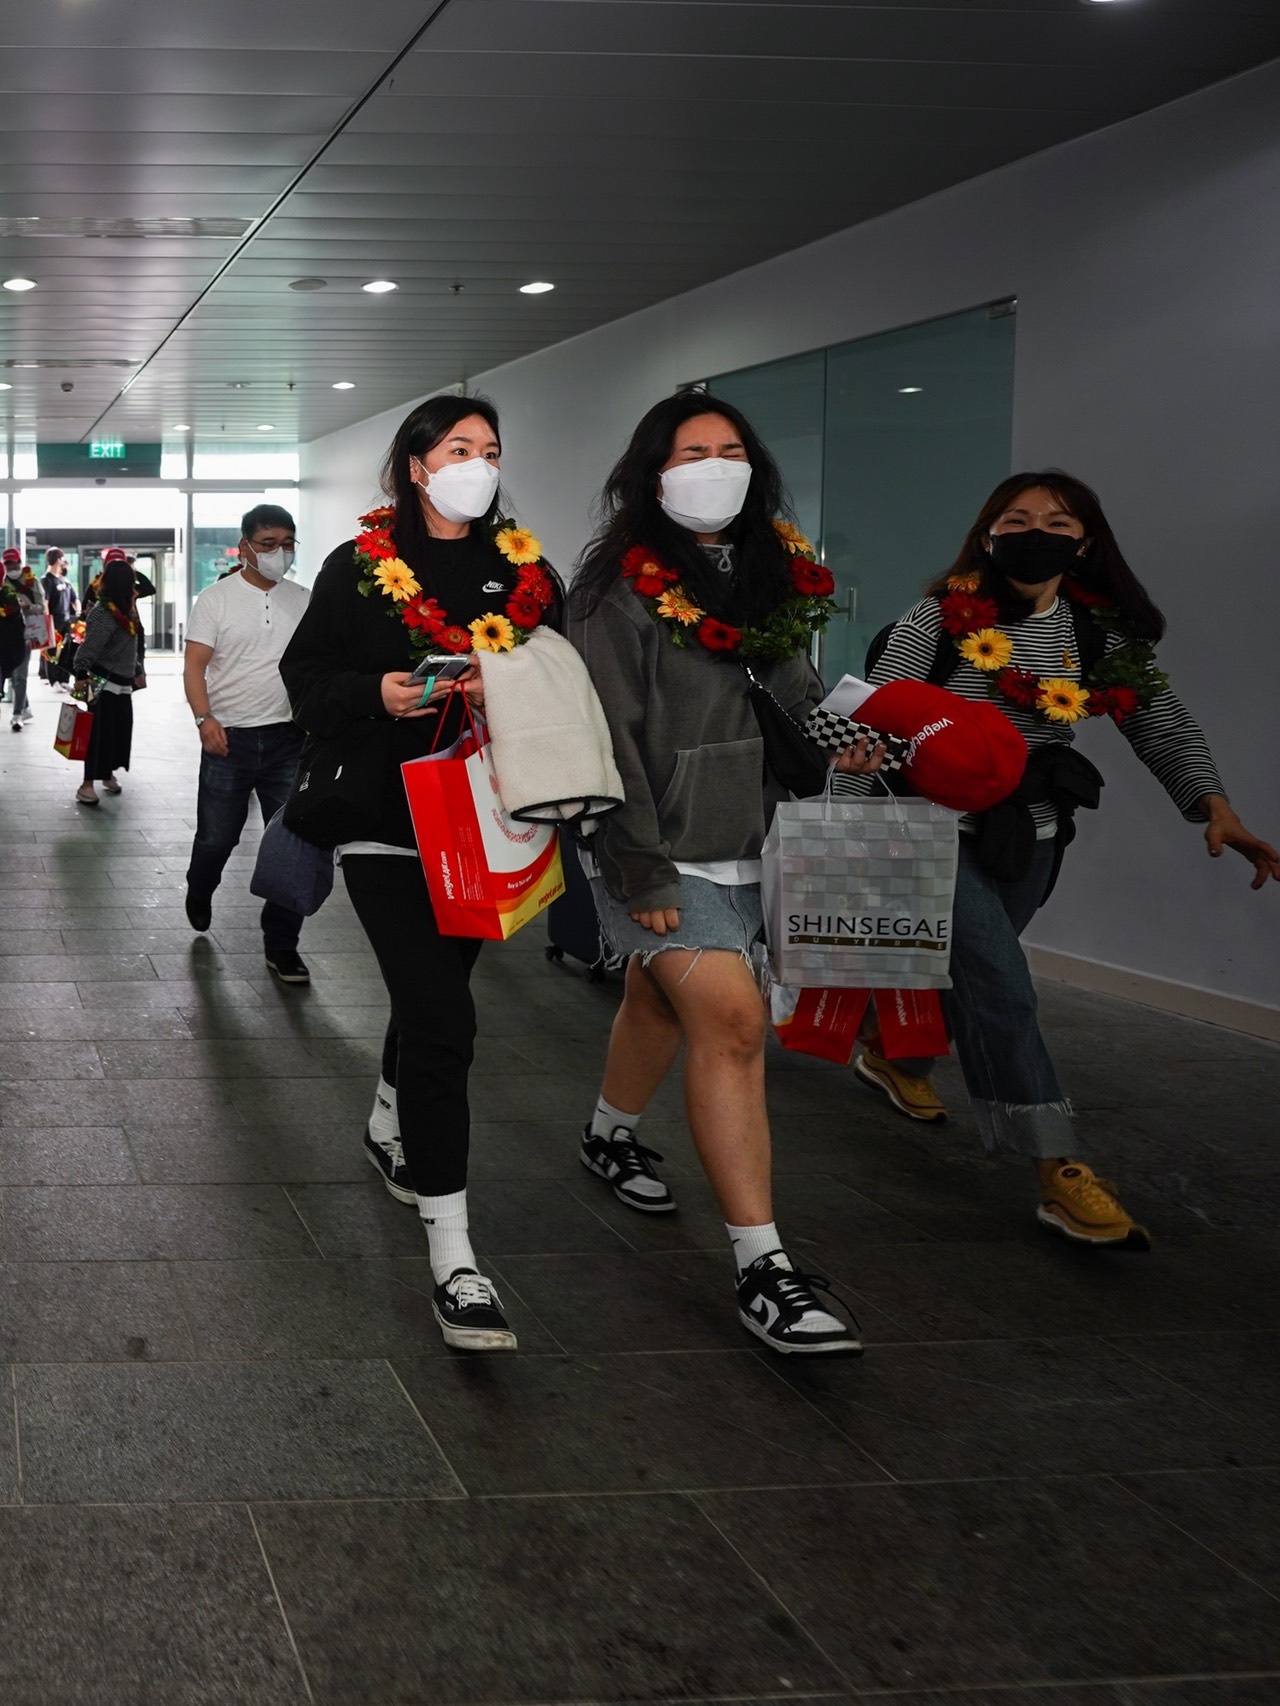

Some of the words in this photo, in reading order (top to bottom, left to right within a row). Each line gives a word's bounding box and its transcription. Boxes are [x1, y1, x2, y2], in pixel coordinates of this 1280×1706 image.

[91, 443, 125, 458] EXIT
[788, 914, 948, 939] SHINSEGAE
[793, 936, 859, 945] DUTY
[873, 939, 944, 950] FREE
